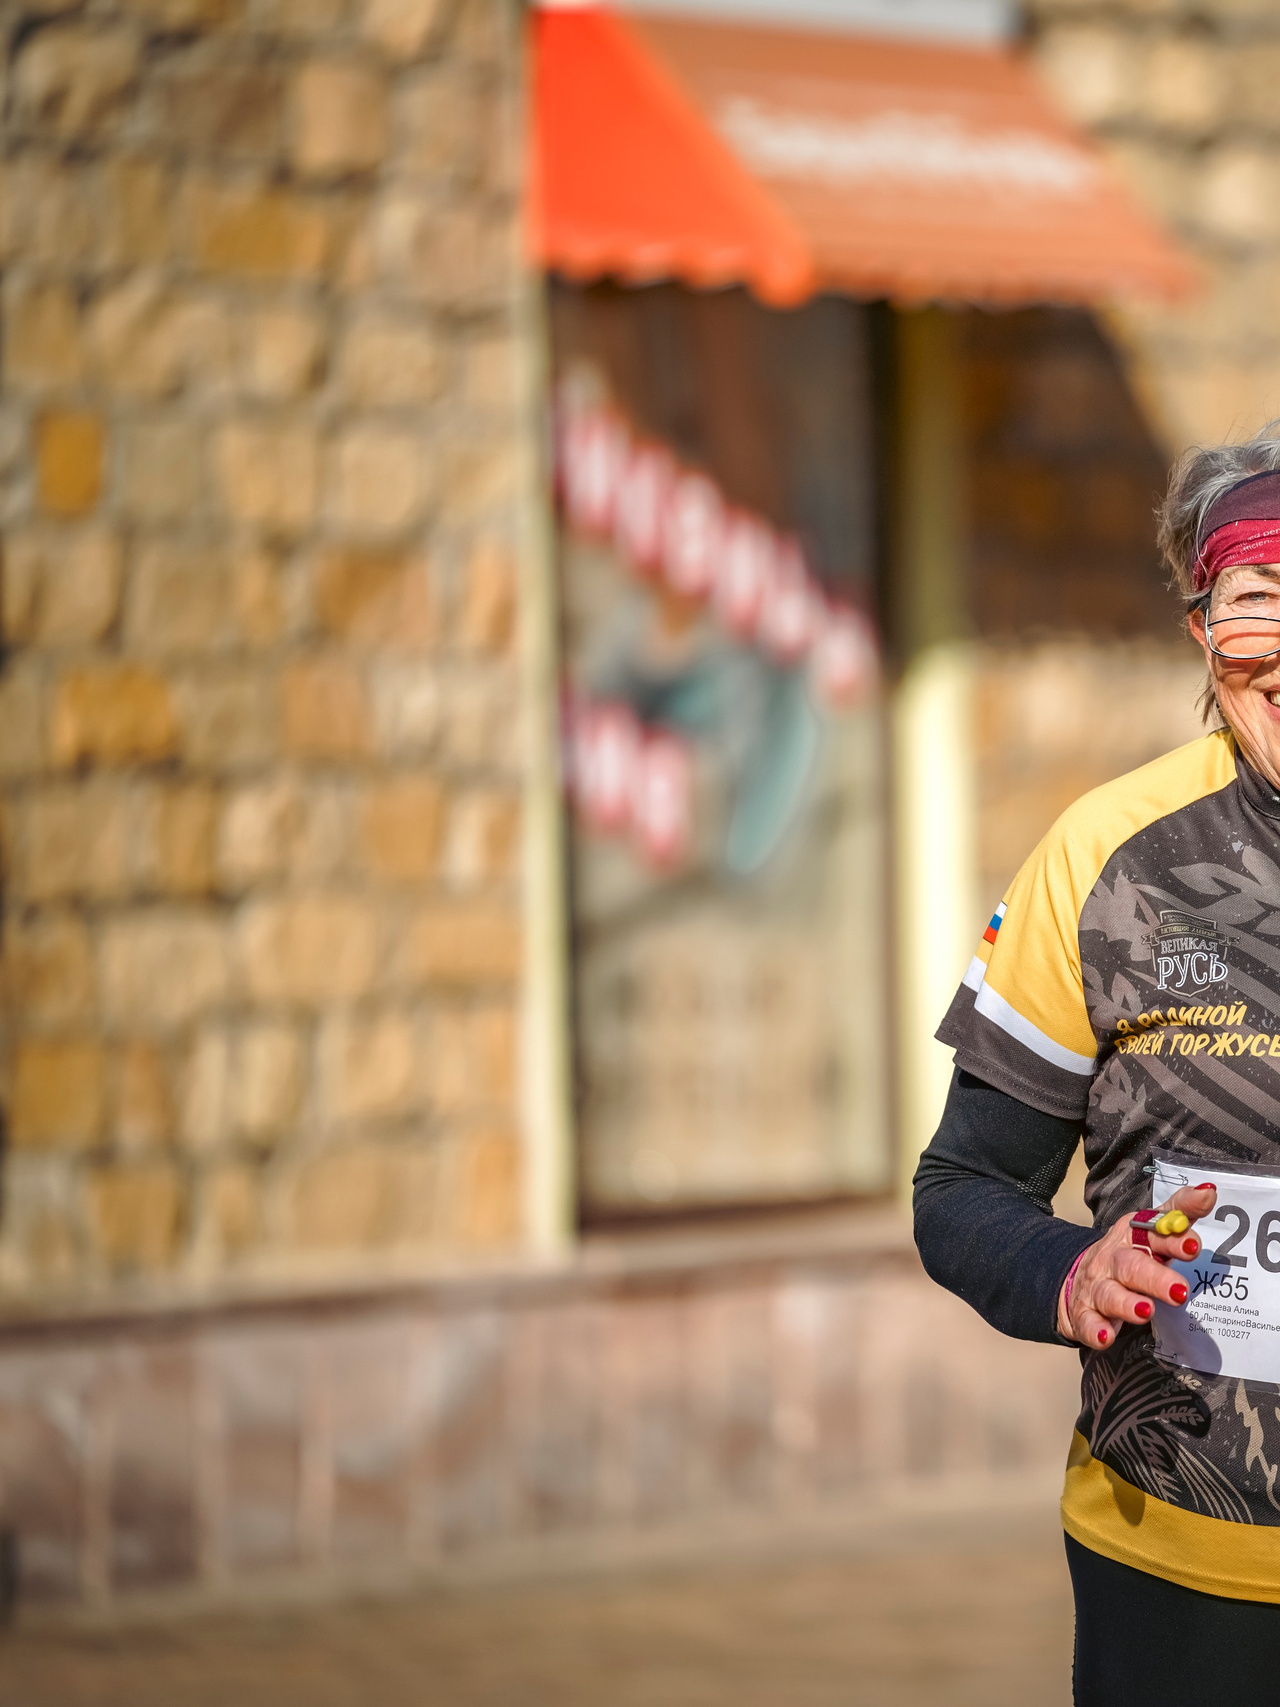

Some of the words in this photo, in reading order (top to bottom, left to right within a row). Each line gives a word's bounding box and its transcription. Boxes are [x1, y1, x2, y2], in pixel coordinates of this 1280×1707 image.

[1160, 936, 1219, 954] ВЕЛИКАЯ
[1157, 951, 1229, 990] РУСЬ
[1116, 1019, 1134, 1034] Я
[1137, 1001, 1248, 1028] РОДИНОЙ
[1114, 1030, 1166, 1056] СВОЕЙ
[1192, 1269, 1249, 1301] Ж55
[1190, 1298, 1232, 1314] Казанцева
[1233, 1304, 1260, 1317] Алина
[1217, 1328, 1251, 1341] 1003277
